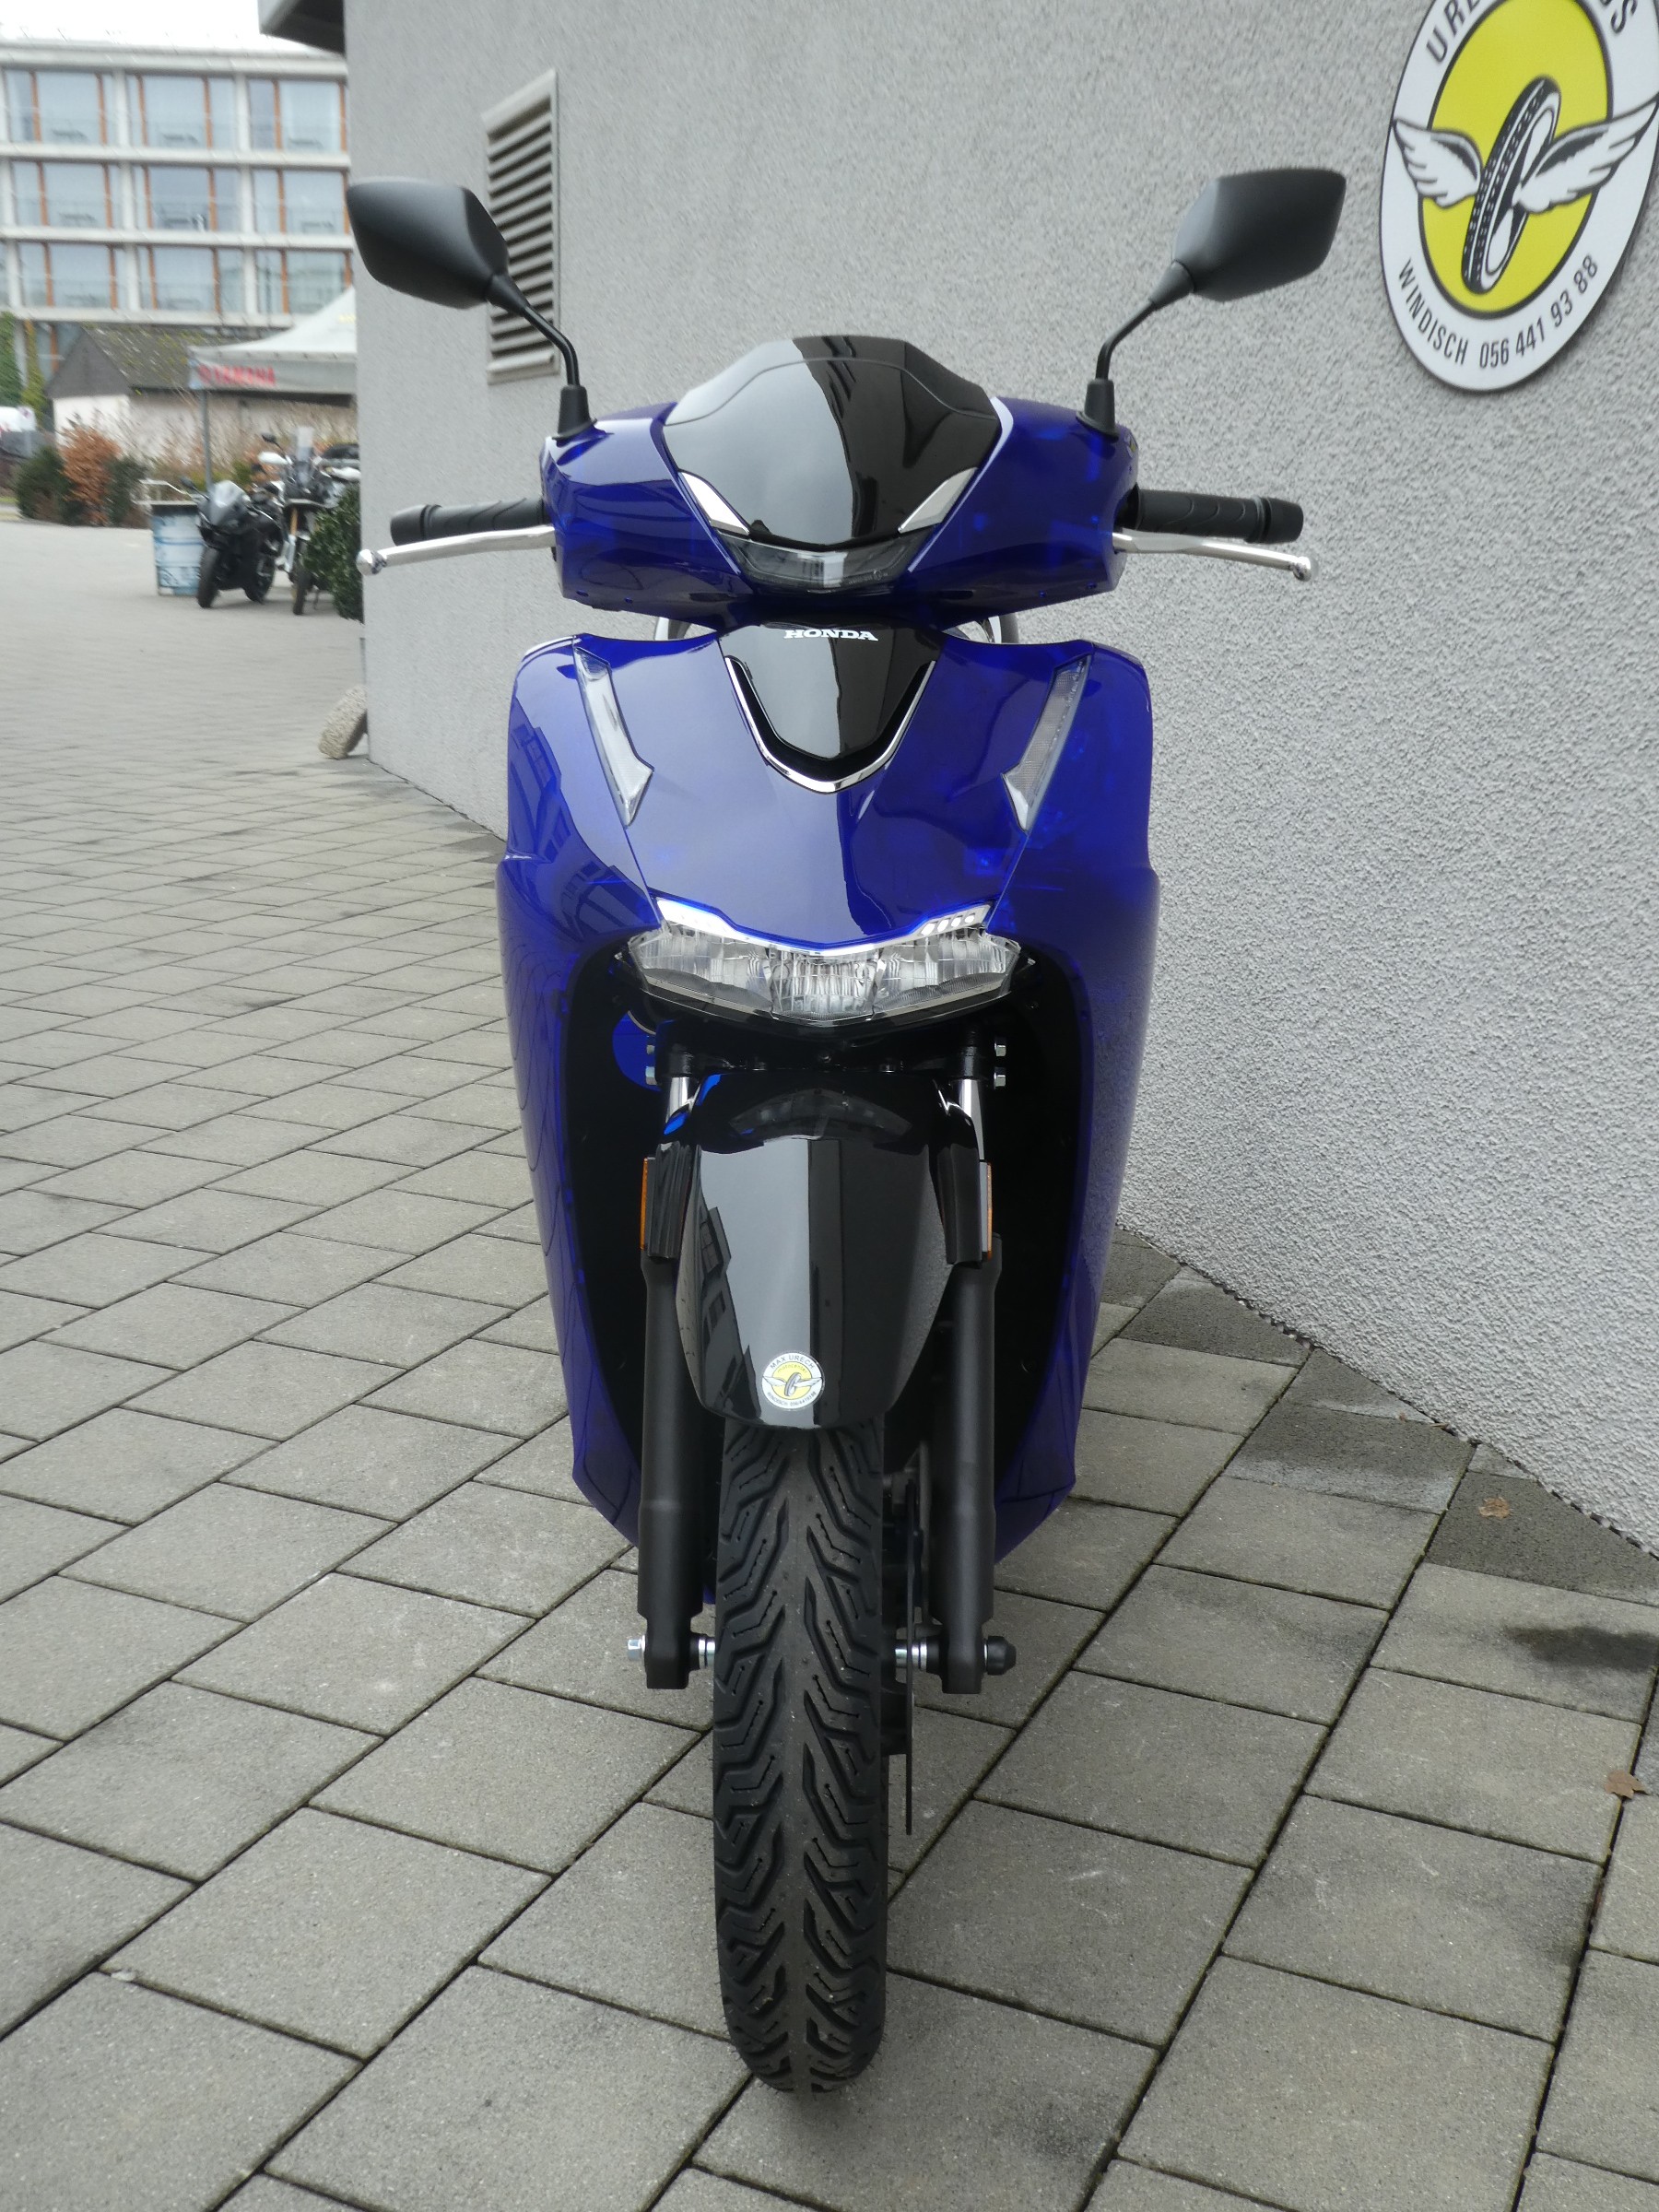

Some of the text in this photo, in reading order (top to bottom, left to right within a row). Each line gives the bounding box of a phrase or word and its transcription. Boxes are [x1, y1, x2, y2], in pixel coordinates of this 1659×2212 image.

[1399, 254, 1598, 369] WINDISCH 056 441 93 88
[783, 629, 878, 641] HONDA
[770, 1355, 816, 1370] MAX URECH
